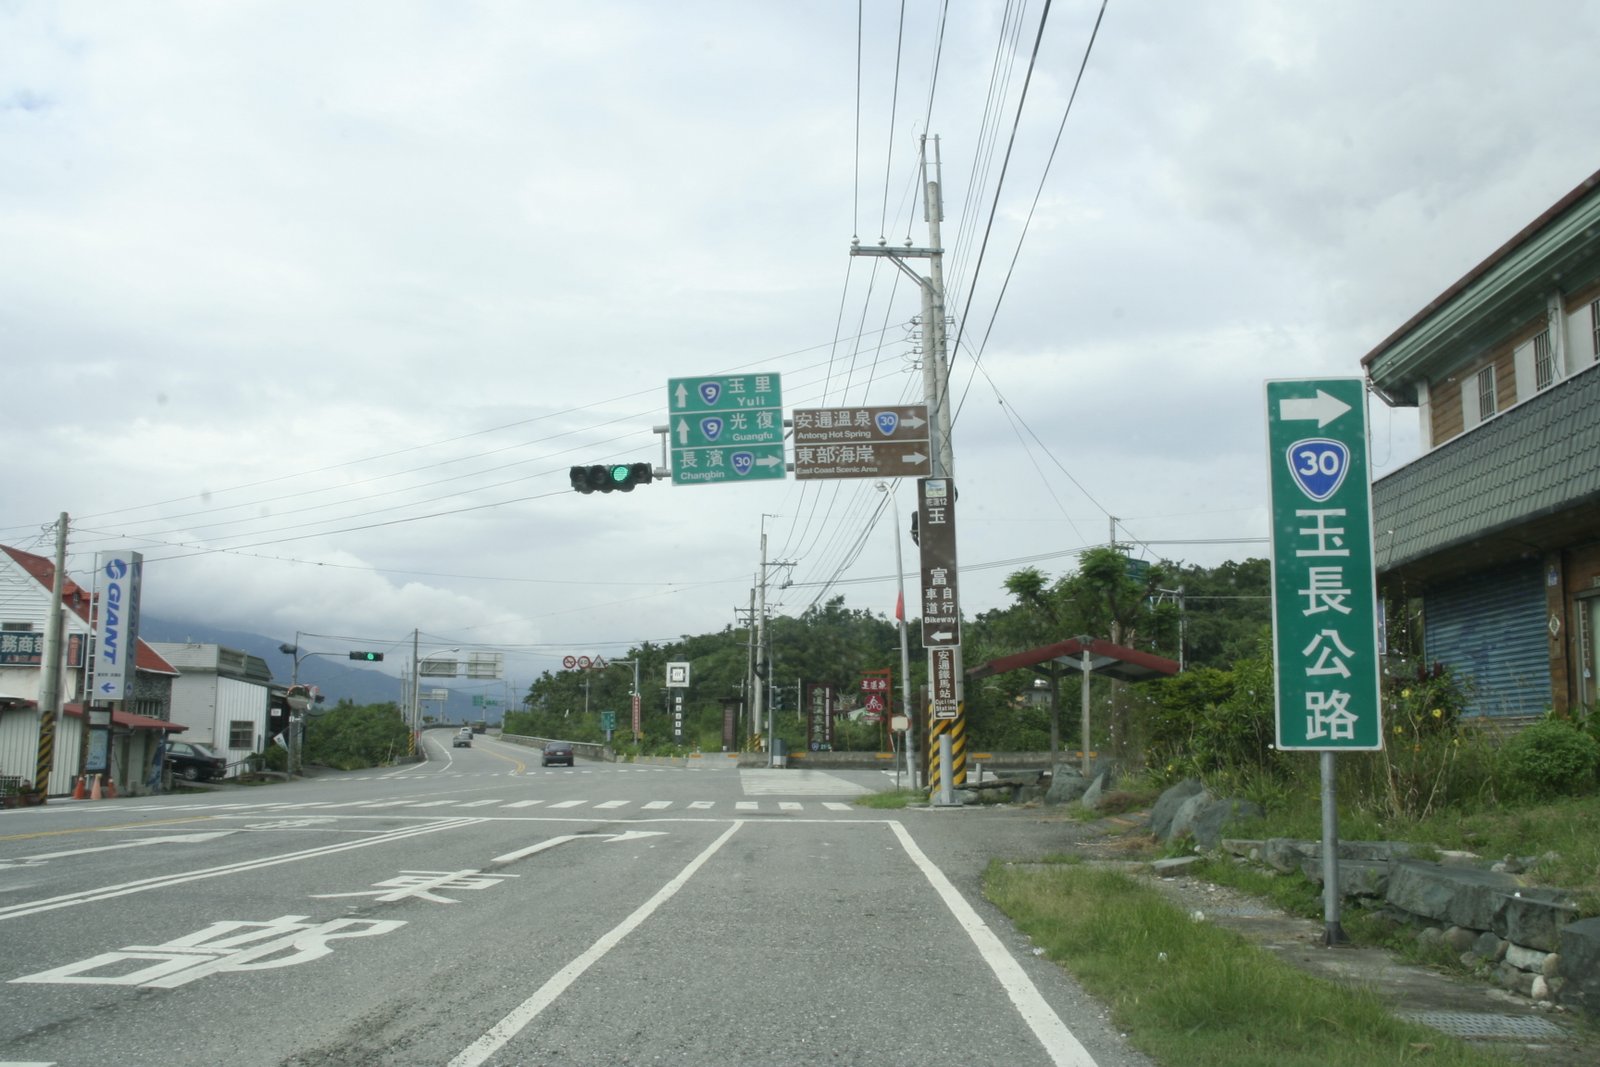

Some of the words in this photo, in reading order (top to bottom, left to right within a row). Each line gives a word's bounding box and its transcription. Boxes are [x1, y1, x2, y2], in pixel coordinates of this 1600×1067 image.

[728, 376, 772, 393] 玉里
[705, 387, 716, 399] 9
[737, 396, 765, 406] Yuli
[730, 411, 774, 430] 光復
[795, 410, 871, 429] 安通溫泉
[880, 416, 895, 426] 30
[707, 422, 718, 435] 9
[797, 431, 828, 440] Antong
[845, 430, 871, 439] Spring
[732, 432, 773, 441] Guangfu
[680, 449, 724, 469] 長濱
[796, 445, 875, 465] 東部海岸
[735, 457, 751, 467] 30
[1299, 450, 1339, 476] 30
[680, 471, 725, 481] Changbin
[104, 582, 121, 665] GIANT
[924, 616, 956, 624] Bikeway
[1295, 508, 1359, 741] 玉長公路
